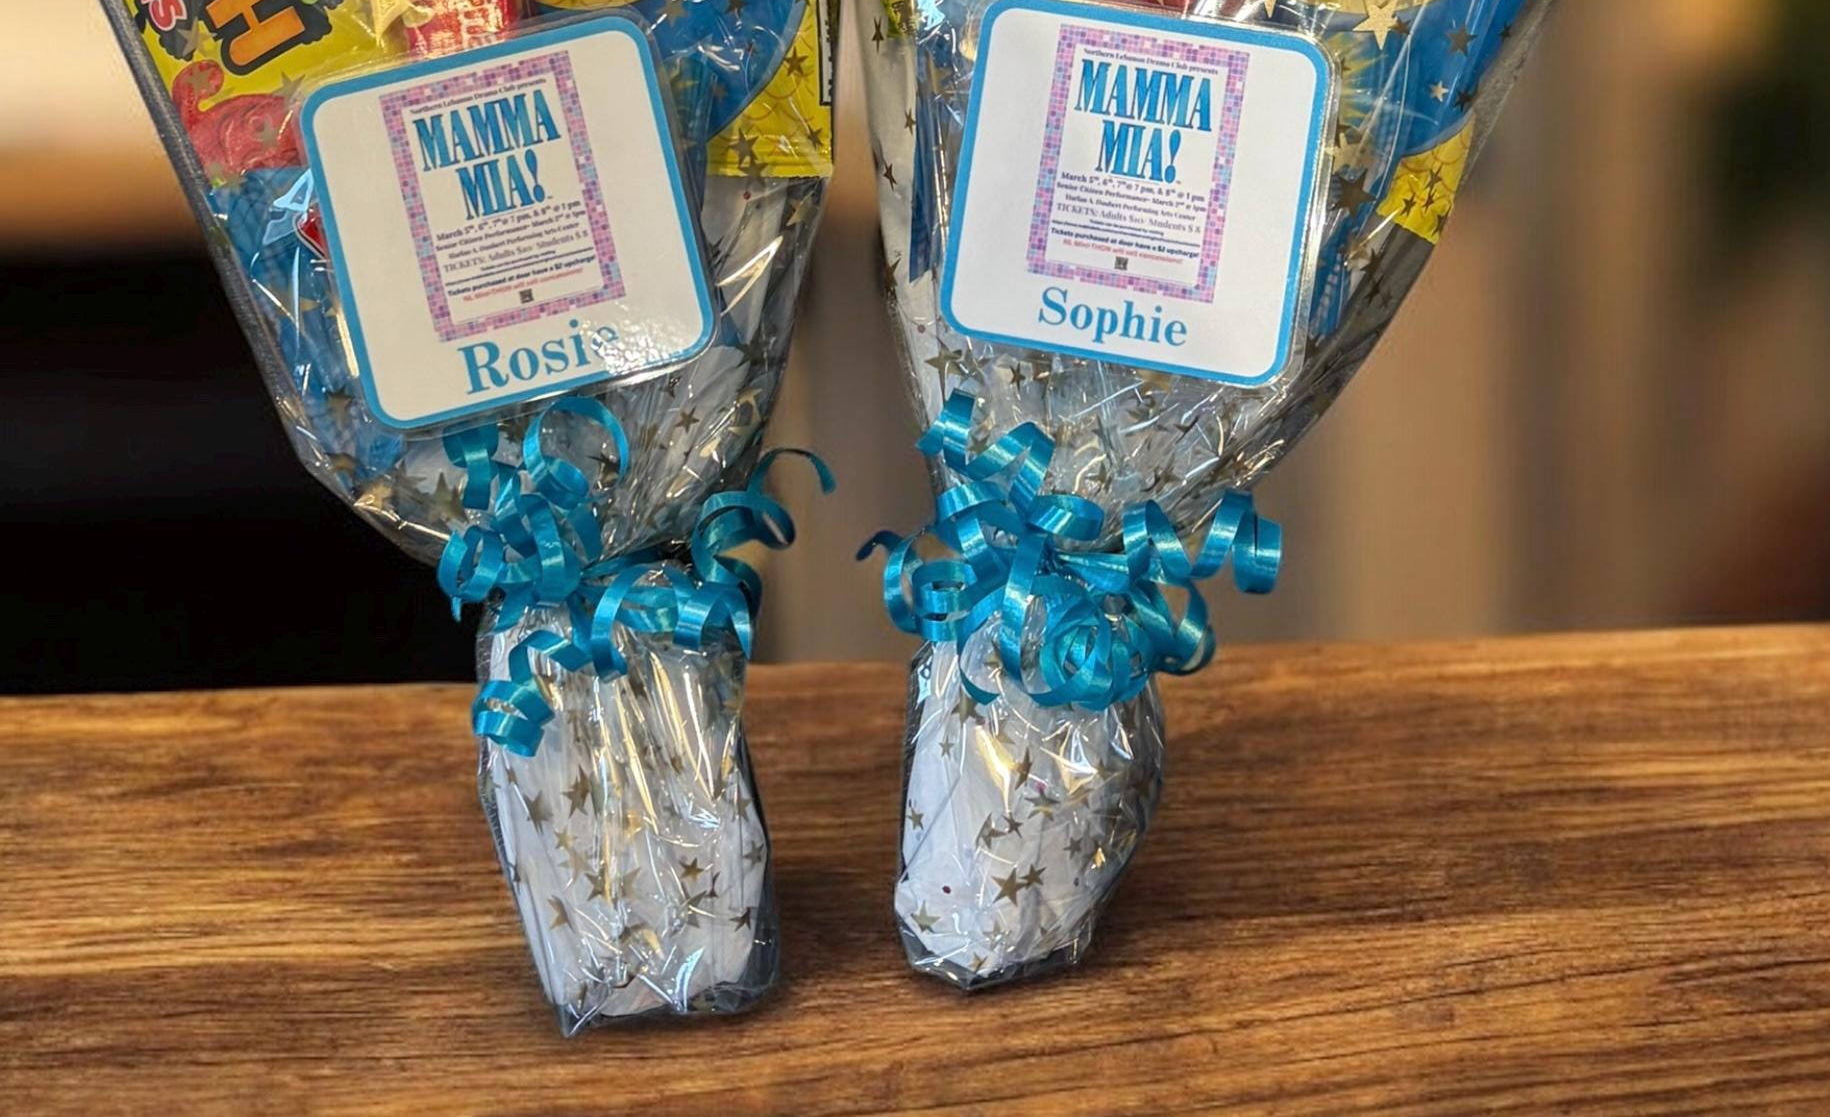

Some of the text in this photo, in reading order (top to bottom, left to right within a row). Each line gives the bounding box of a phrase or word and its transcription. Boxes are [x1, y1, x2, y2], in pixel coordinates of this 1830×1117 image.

[1083, 48, 1218, 75] Northern Lebanon Drama Club presents
[1074, 58, 1213, 133] MAMMA
[412, 88, 562, 172] MAMMA
[1095, 119, 1182, 184] MIA!
[455, 148, 548, 221] MIA!
[1056, 182, 1077, 191] Senior
[1079, 185, 1103, 195] Citizen
[1151, 197, 1173, 206] March
[1061, 171, 1087, 182] March
[1157, 186, 1163, 194] &
[1191, 192, 1205, 203] pm
[435, 227, 463, 241] March
[566, 198, 581, 210] pm
[1051, 227, 1073, 236] Tickets
[1074, 231, 1109, 244] purchased
[1109, 236, 1117, 244] at
[1118, 238, 1133, 246] door
[1134, 241, 1150, 249] have
[1056, 202, 1099, 216] TICKETS:
[1100, 209, 1127, 221] Adults
[1148, 217, 1186, 231] Students
[447, 285, 471, 296] Tickets
[471, 276, 506, 292] purchased
[1037, 285, 1188, 347] Sophie
[457, 318, 621, 394] Rosie
